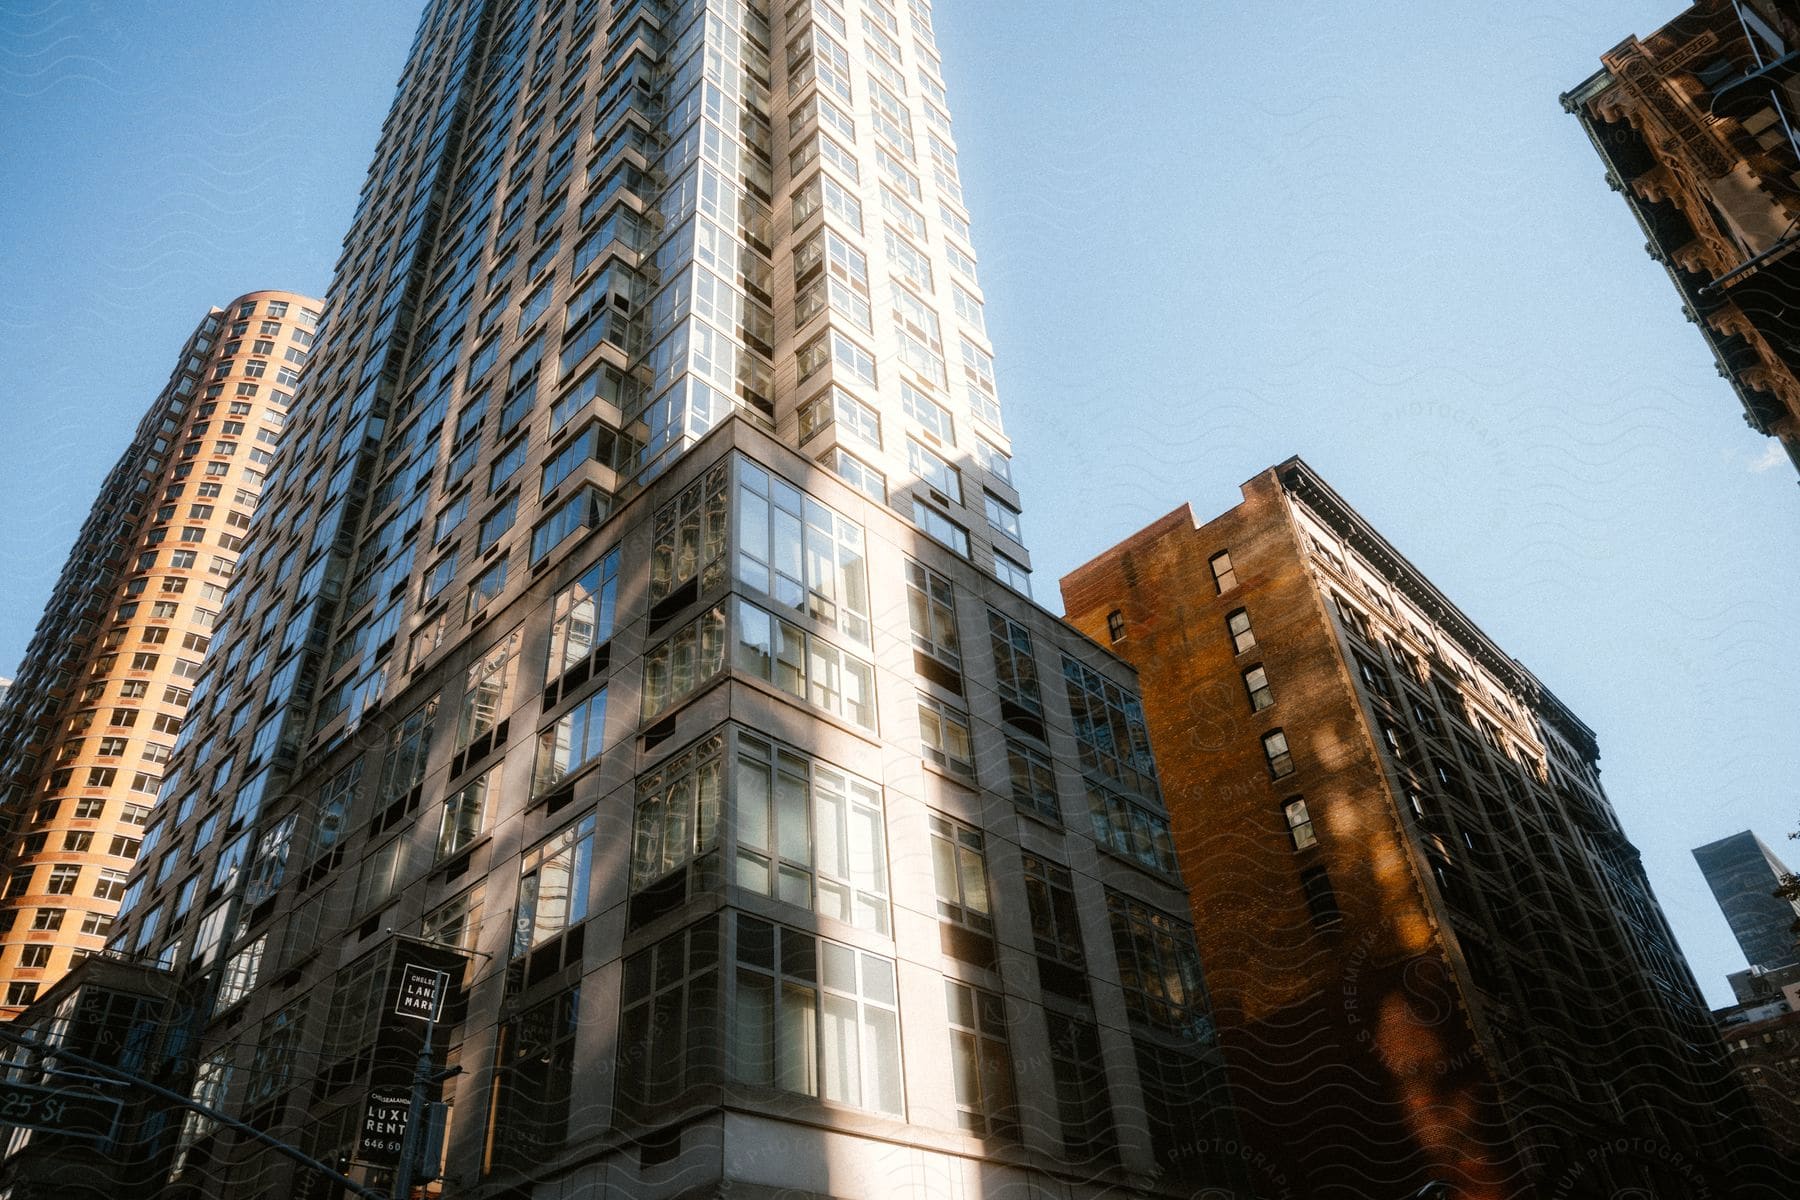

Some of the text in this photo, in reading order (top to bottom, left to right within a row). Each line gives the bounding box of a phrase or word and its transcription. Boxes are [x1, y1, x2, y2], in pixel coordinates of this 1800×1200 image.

[1, 1092, 66, 1123] 25 St
[366, 1119, 406, 1135] RENT
[364, 1138, 401, 1151] 646 60
